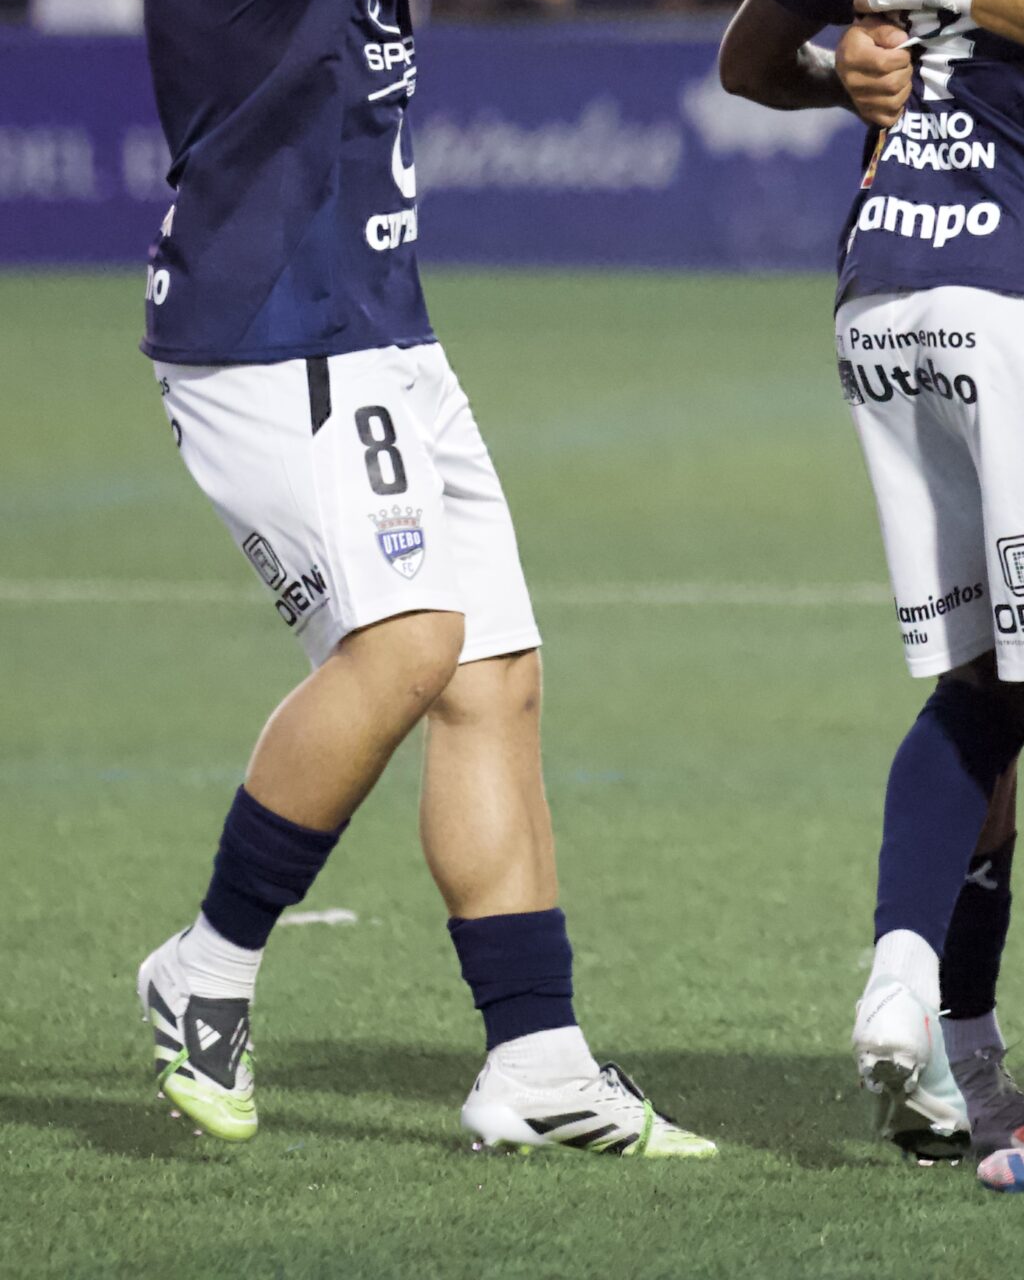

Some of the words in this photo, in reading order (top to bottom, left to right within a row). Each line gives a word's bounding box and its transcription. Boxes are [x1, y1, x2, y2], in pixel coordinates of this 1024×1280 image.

[850, 327, 977, 350] Pavimentos
[856, 358, 978, 404] Utebo
[354, 405, 408, 496] 8
[382, 530, 422, 555] UTEBO
